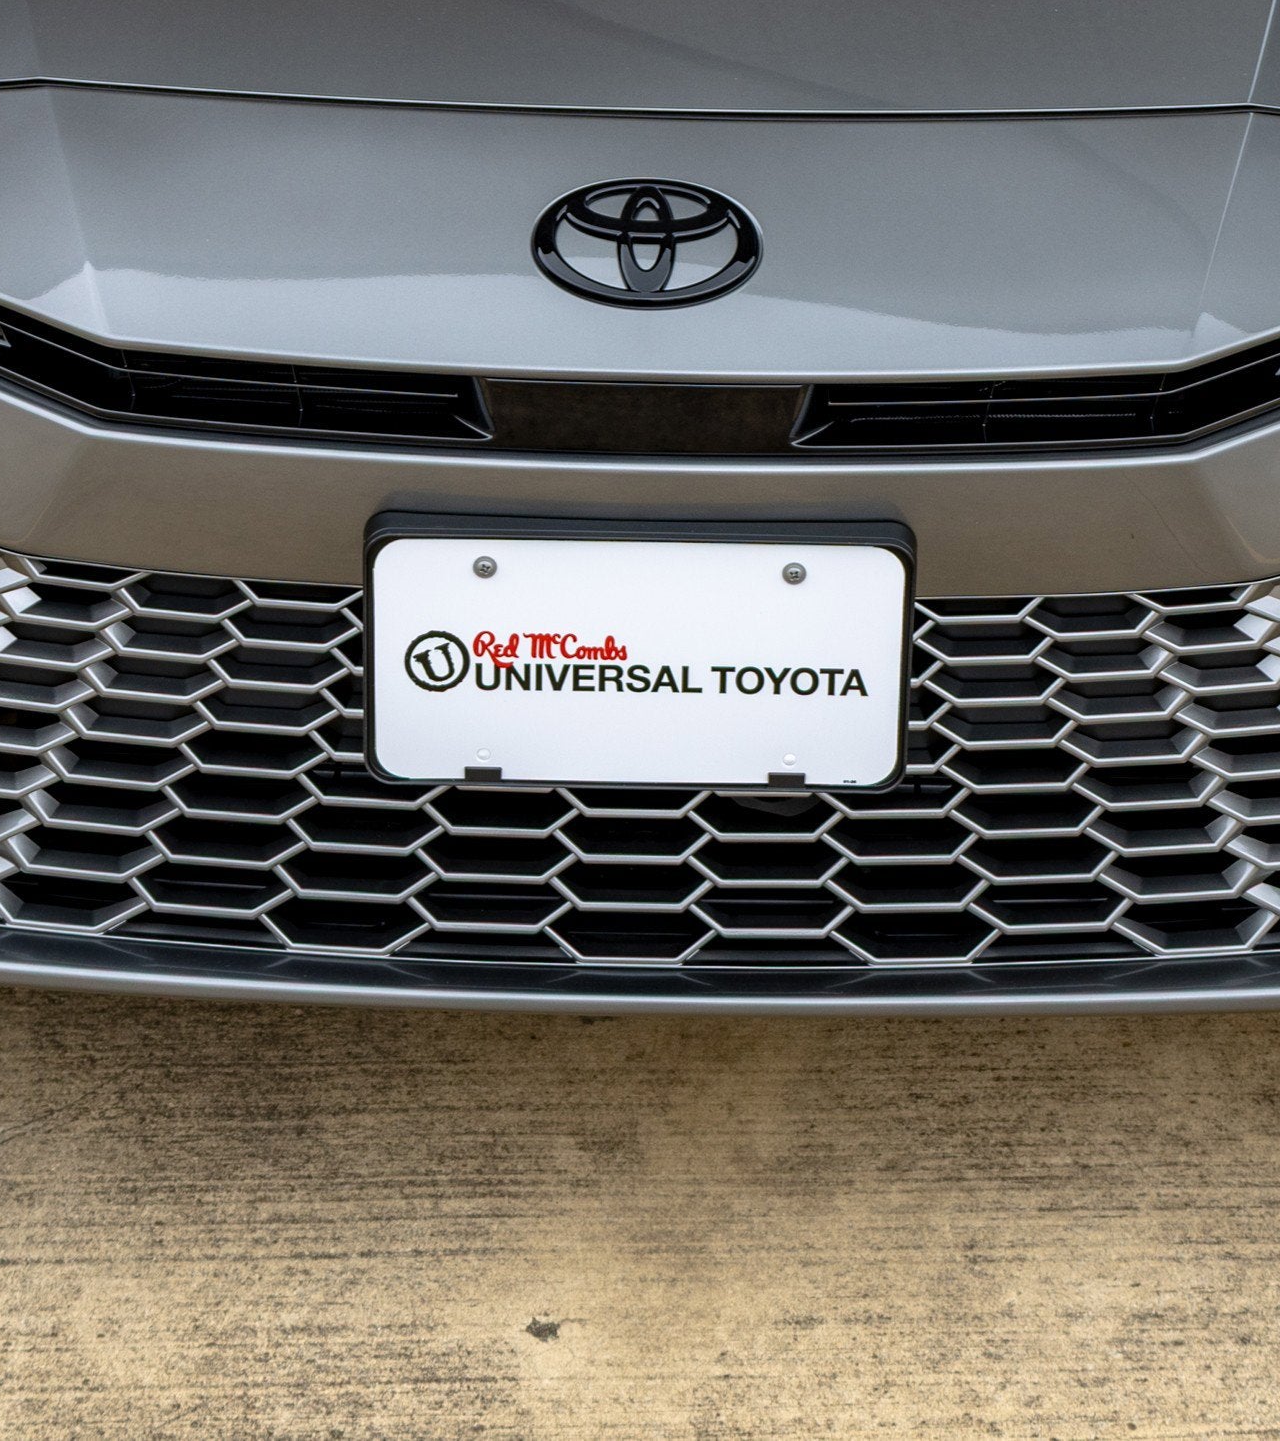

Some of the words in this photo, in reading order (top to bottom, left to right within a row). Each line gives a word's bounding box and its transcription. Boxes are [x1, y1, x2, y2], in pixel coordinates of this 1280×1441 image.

[473, 630, 520, 668] Red
[523, 632, 628, 661] McCombs
[475, 663, 703, 694] UNIVERSAL
[711, 665, 869, 697] TOYOTA
